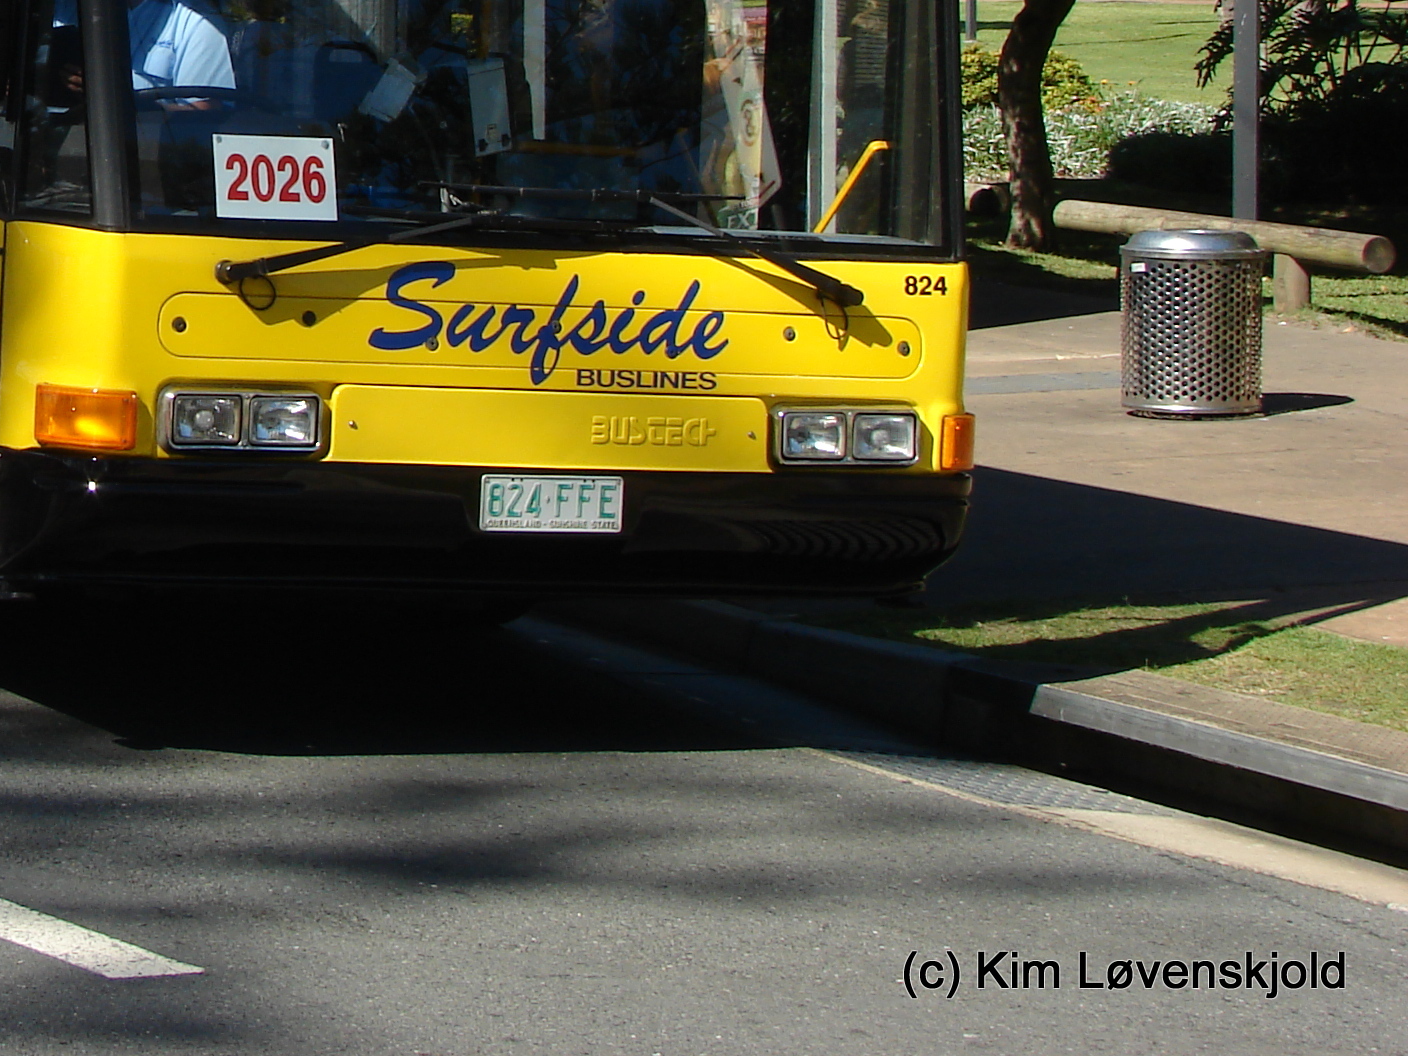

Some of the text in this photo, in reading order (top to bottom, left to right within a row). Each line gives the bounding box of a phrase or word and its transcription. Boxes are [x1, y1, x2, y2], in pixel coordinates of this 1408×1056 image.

[225, 153, 327, 204] 2026
[904, 275, 948, 296] 824
[368, 261, 729, 386] Surfside
[576, 369, 718, 390] BUSLINES
